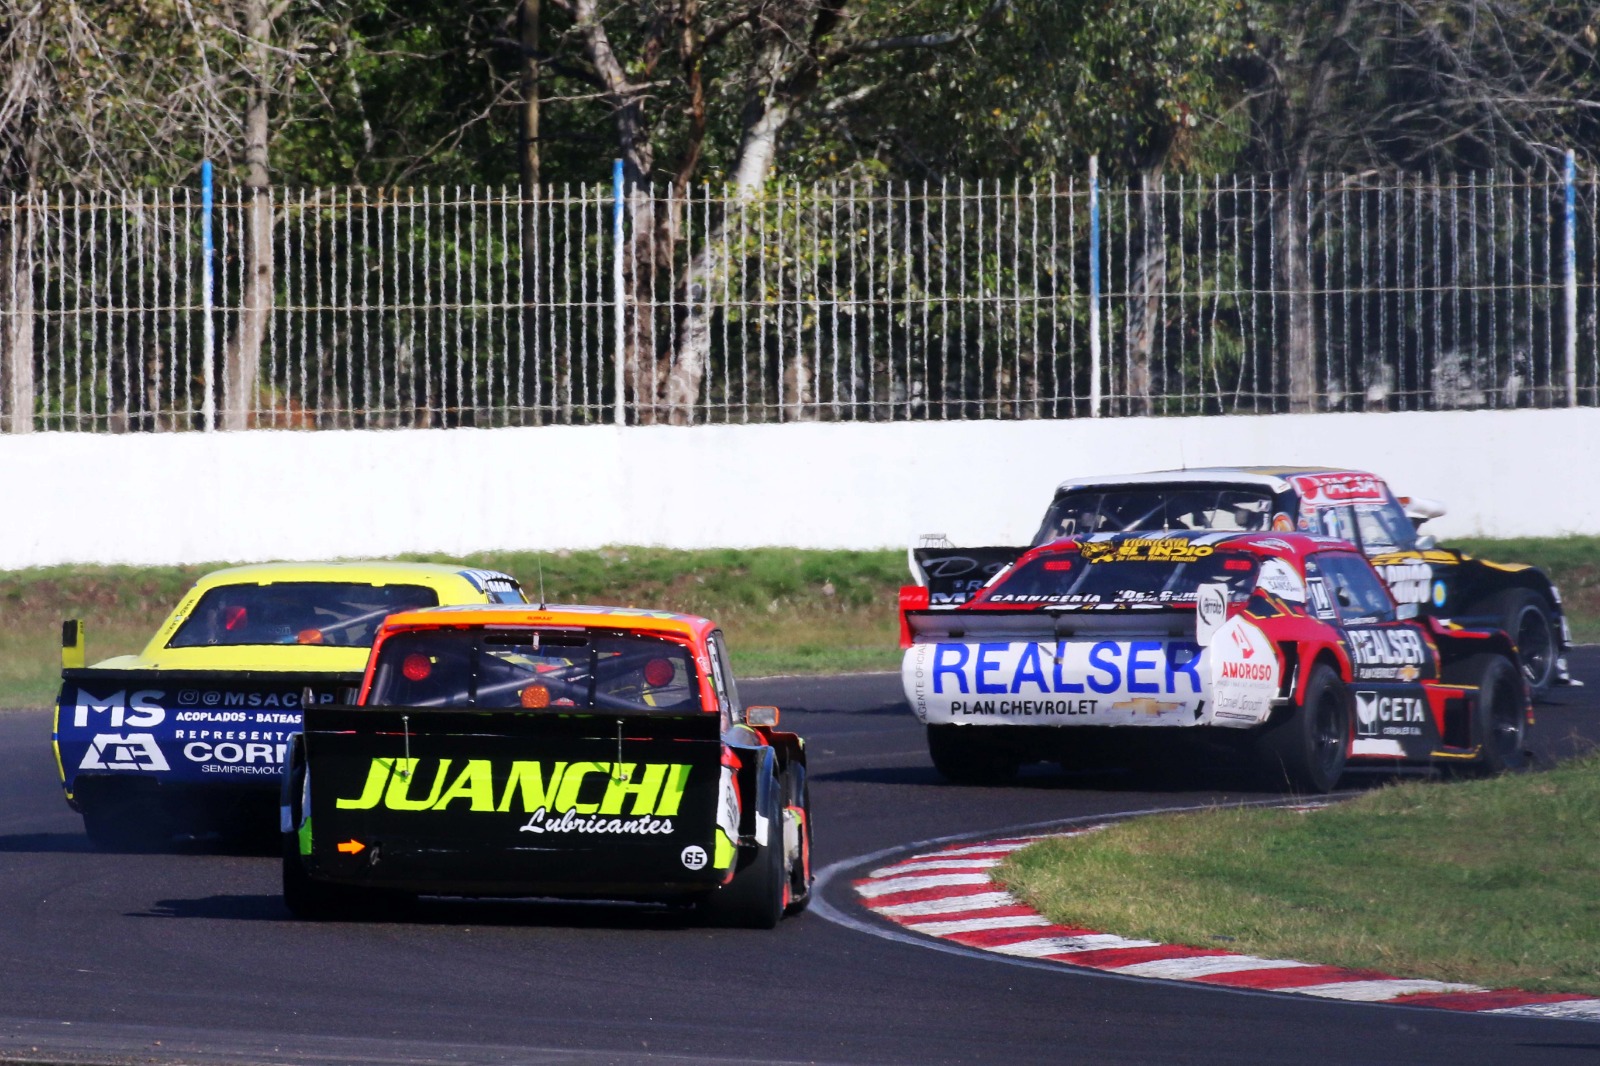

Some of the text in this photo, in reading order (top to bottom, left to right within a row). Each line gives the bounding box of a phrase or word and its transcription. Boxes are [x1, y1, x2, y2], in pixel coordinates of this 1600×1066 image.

[1347, 629, 1425, 664] REALSER
[932, 640, 1202, 695] REALSER
[1221, 661, 1272, 681] AMOROSO
[74, 688, 166, 727] MS
[915, 682, 928, 720] AGENTE
[951, 699, 1098, 715] PLAN CHEVROLET
[1379, 697, 1425, 722] CETA
[175, 712, 246, 723] ACOPLADOS
[256, 712, 302, 724] BATEAS
[335, 757, 693, 817] JUANCHI
[519, 807, 675, 835] Lubricantes
[684, 851, 704, 865] 65
